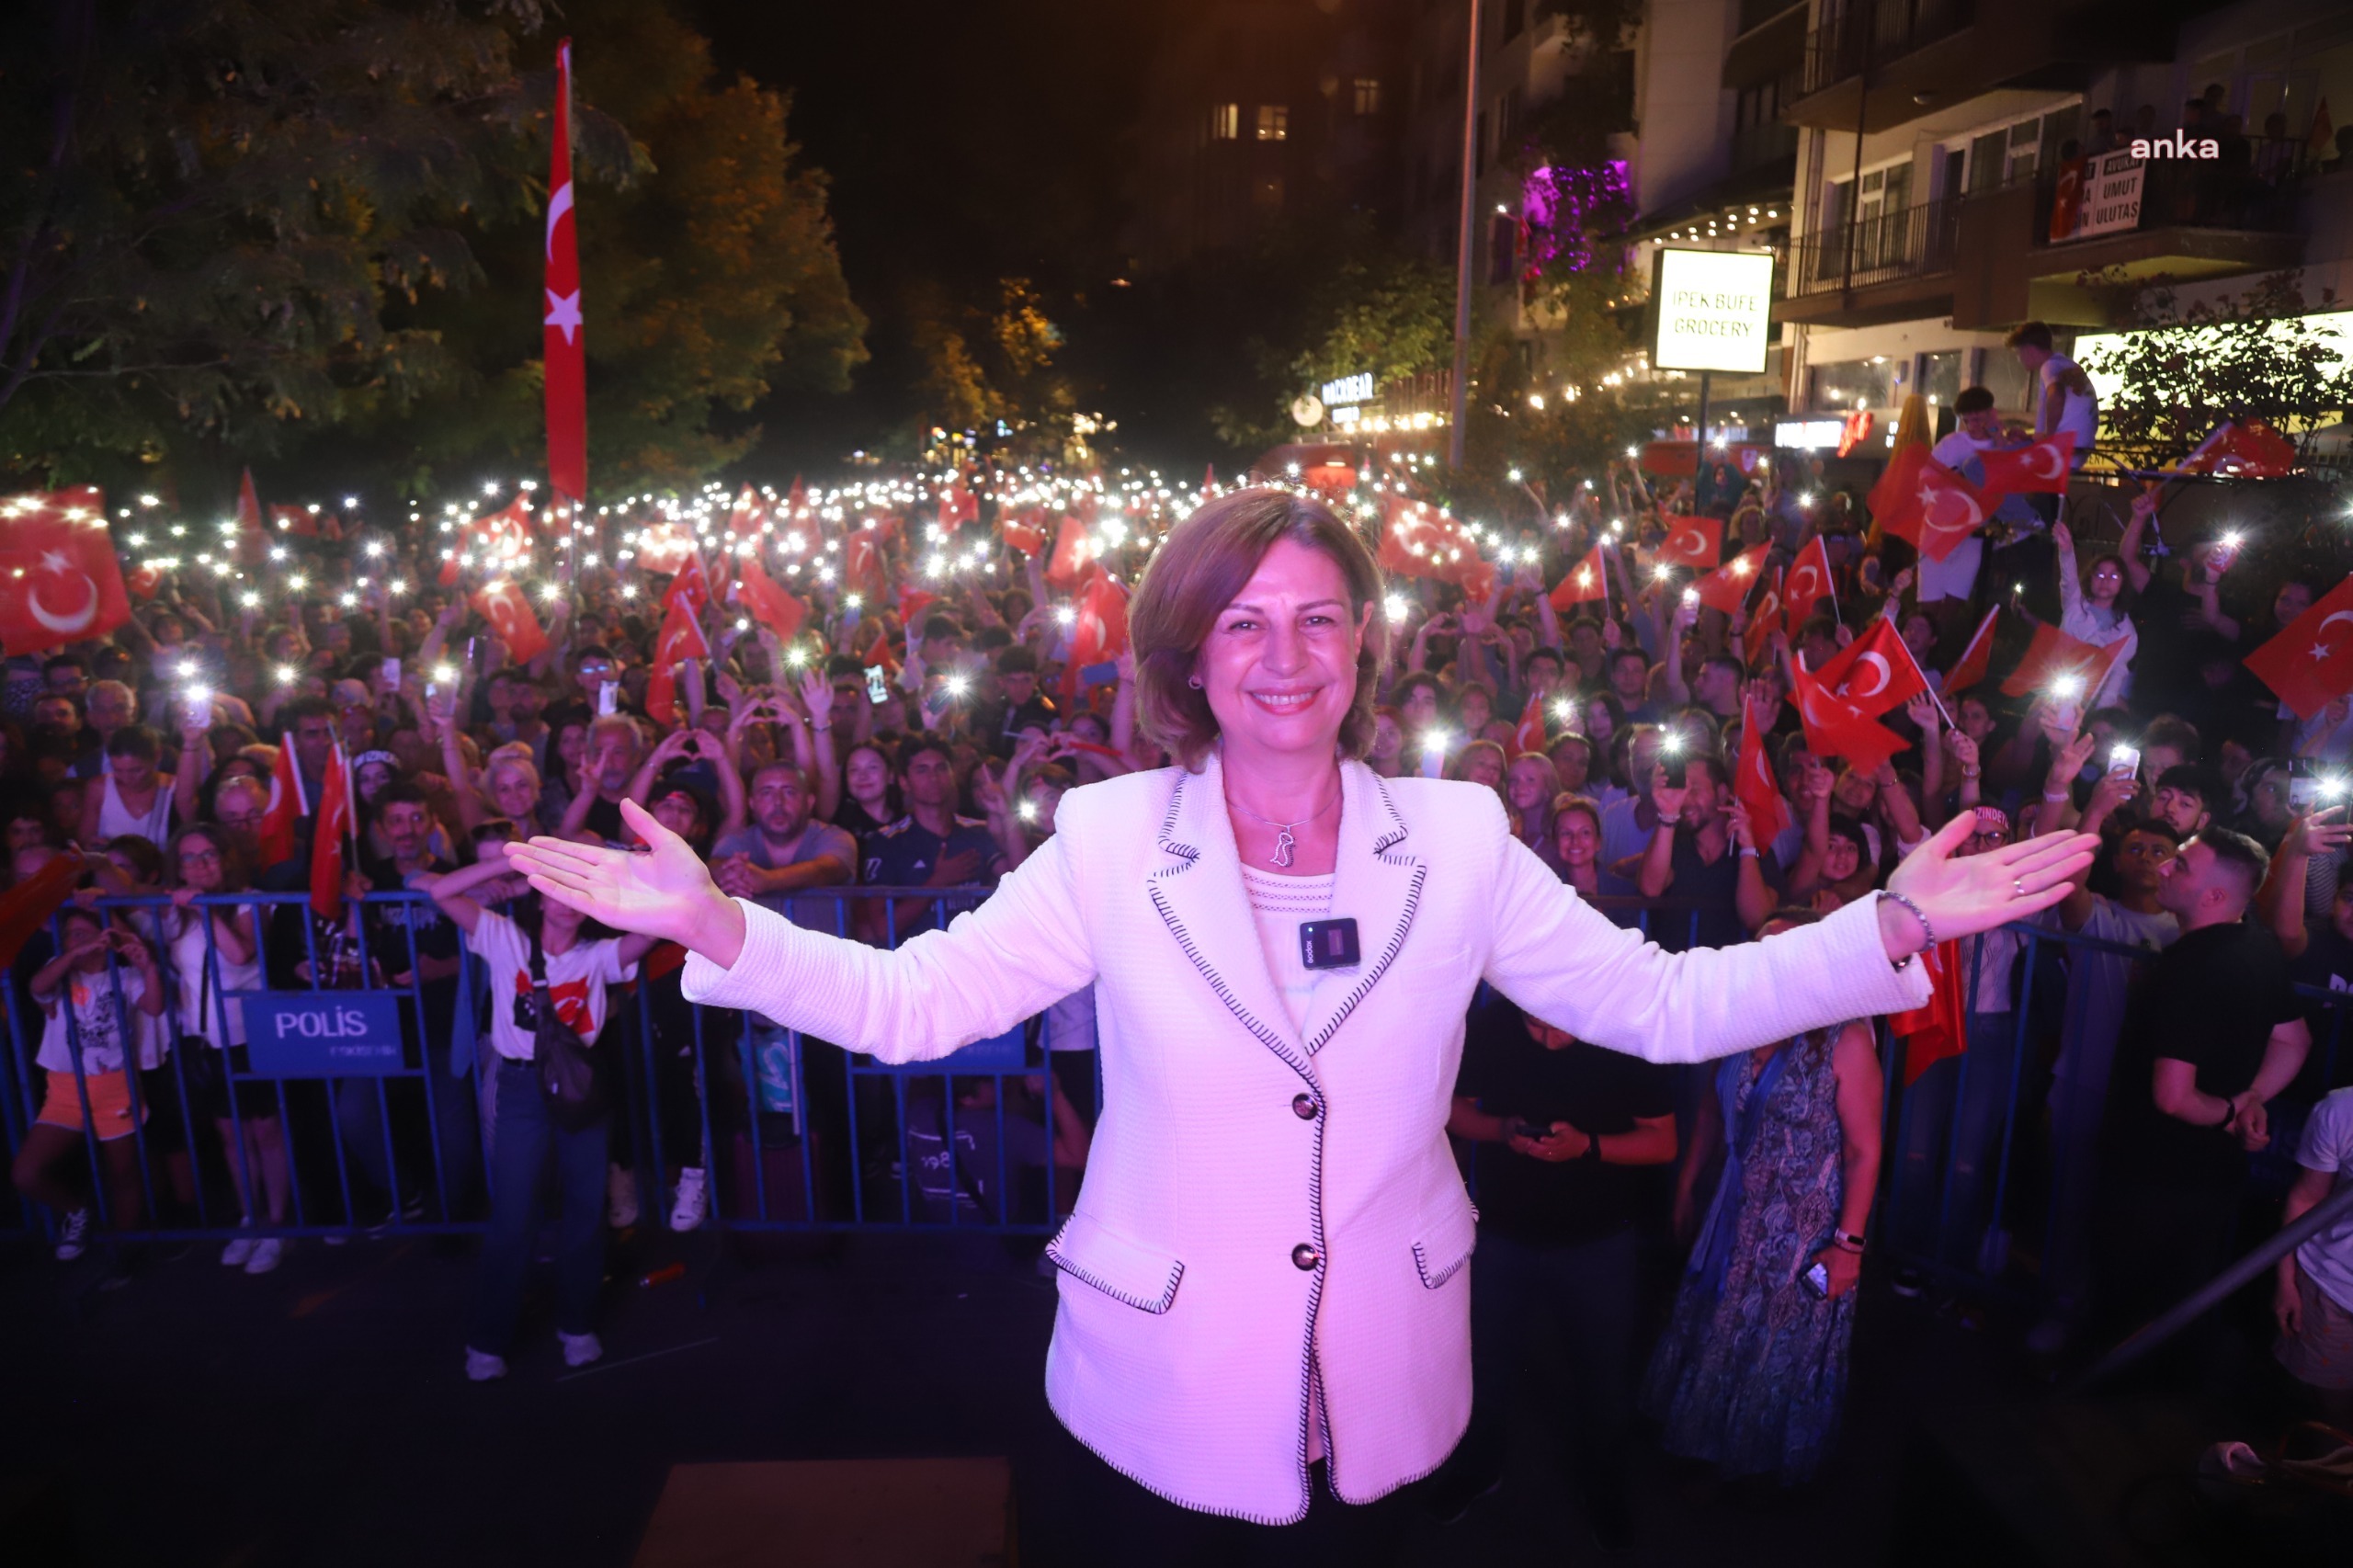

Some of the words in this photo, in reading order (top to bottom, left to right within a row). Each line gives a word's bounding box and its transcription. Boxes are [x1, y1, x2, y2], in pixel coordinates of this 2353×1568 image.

[2103, 176, 2137, 199] UMUT
[1674, 317, 1754, 337] GROCERY
[276, 1006, 368, 1039] POLİS
